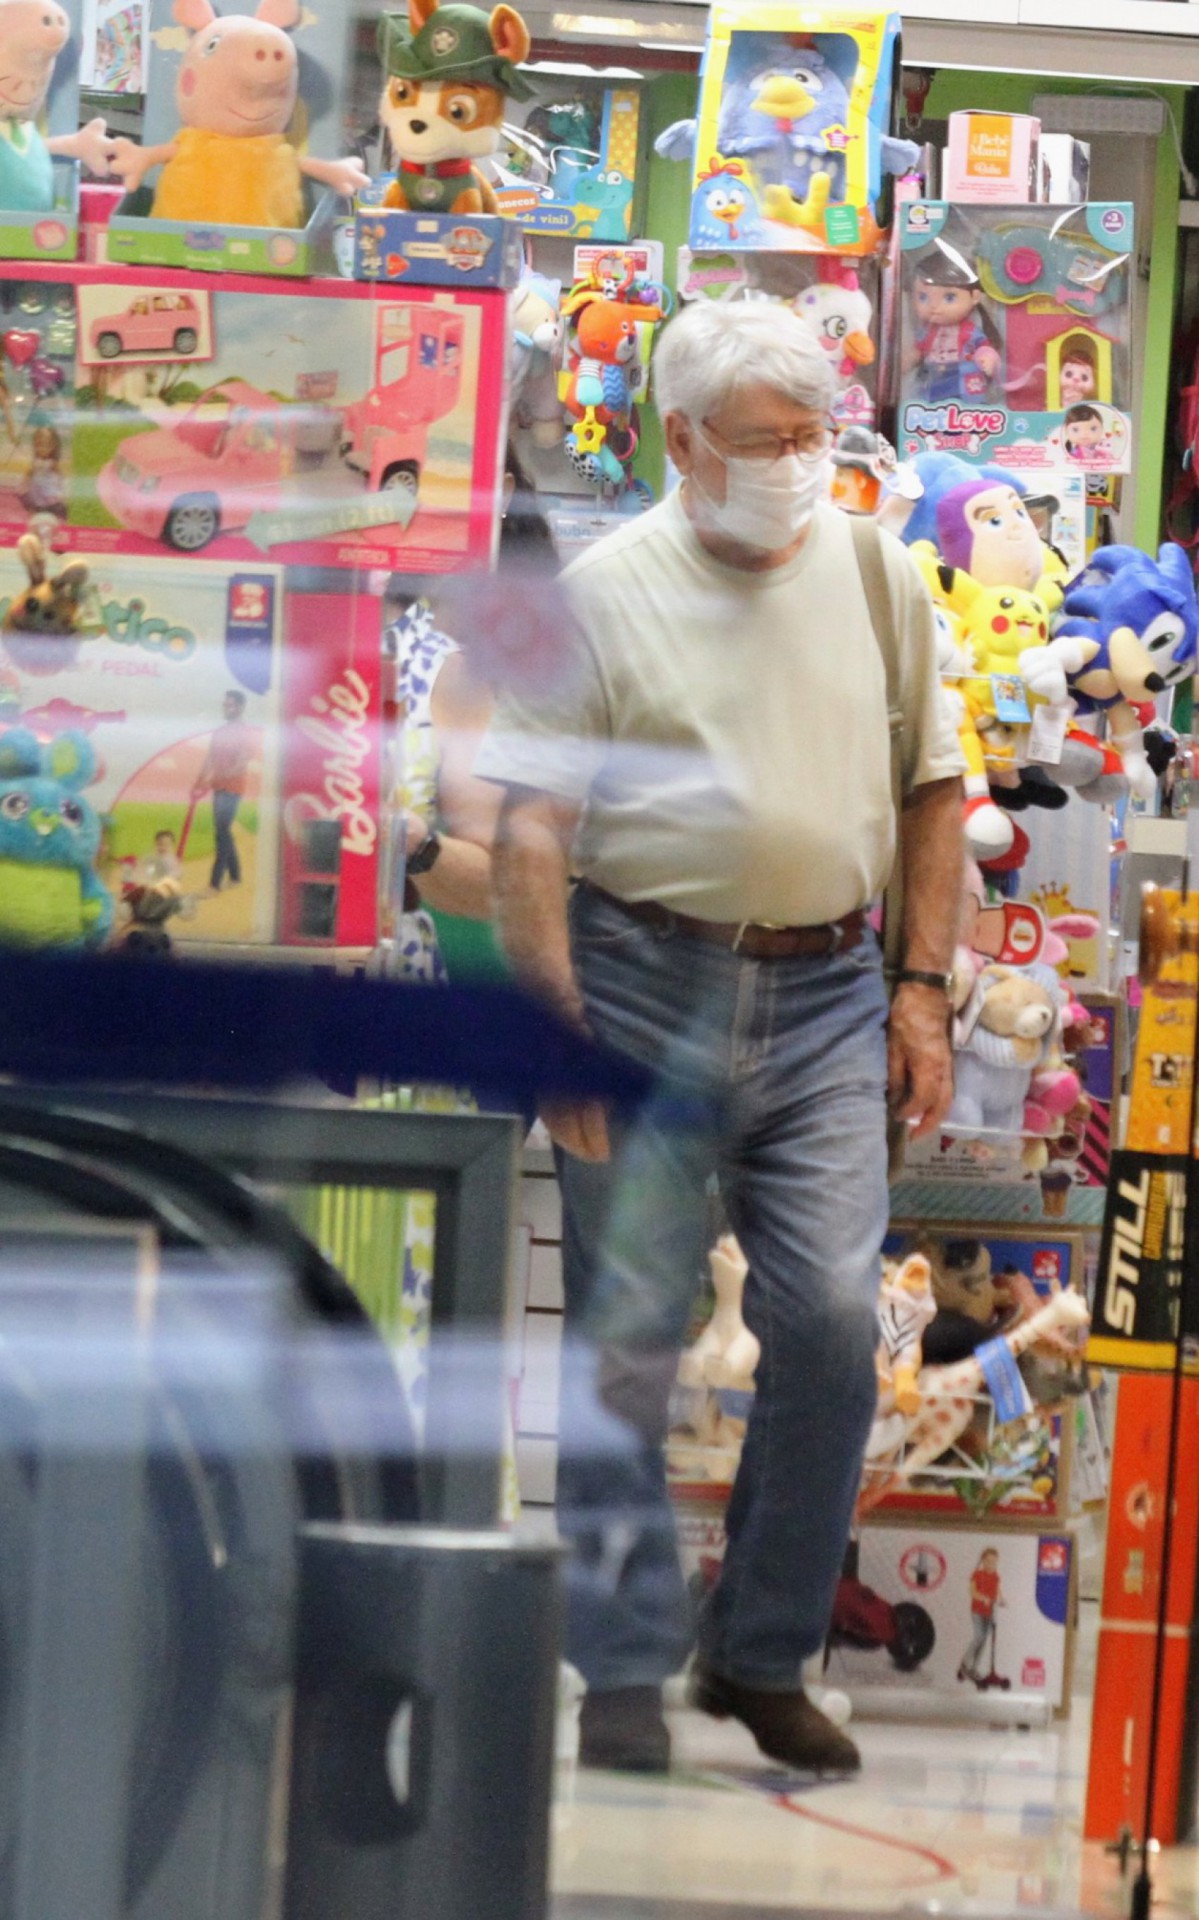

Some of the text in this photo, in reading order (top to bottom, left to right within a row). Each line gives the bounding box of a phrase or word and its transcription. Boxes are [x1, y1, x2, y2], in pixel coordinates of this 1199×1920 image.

[522, 213, 569, 225] de vinil
[906, 405, 1004, 433] PetLove
[284, 669, 379, 857] Barbie
[1104, 1169, 1150, 1337] STILL
